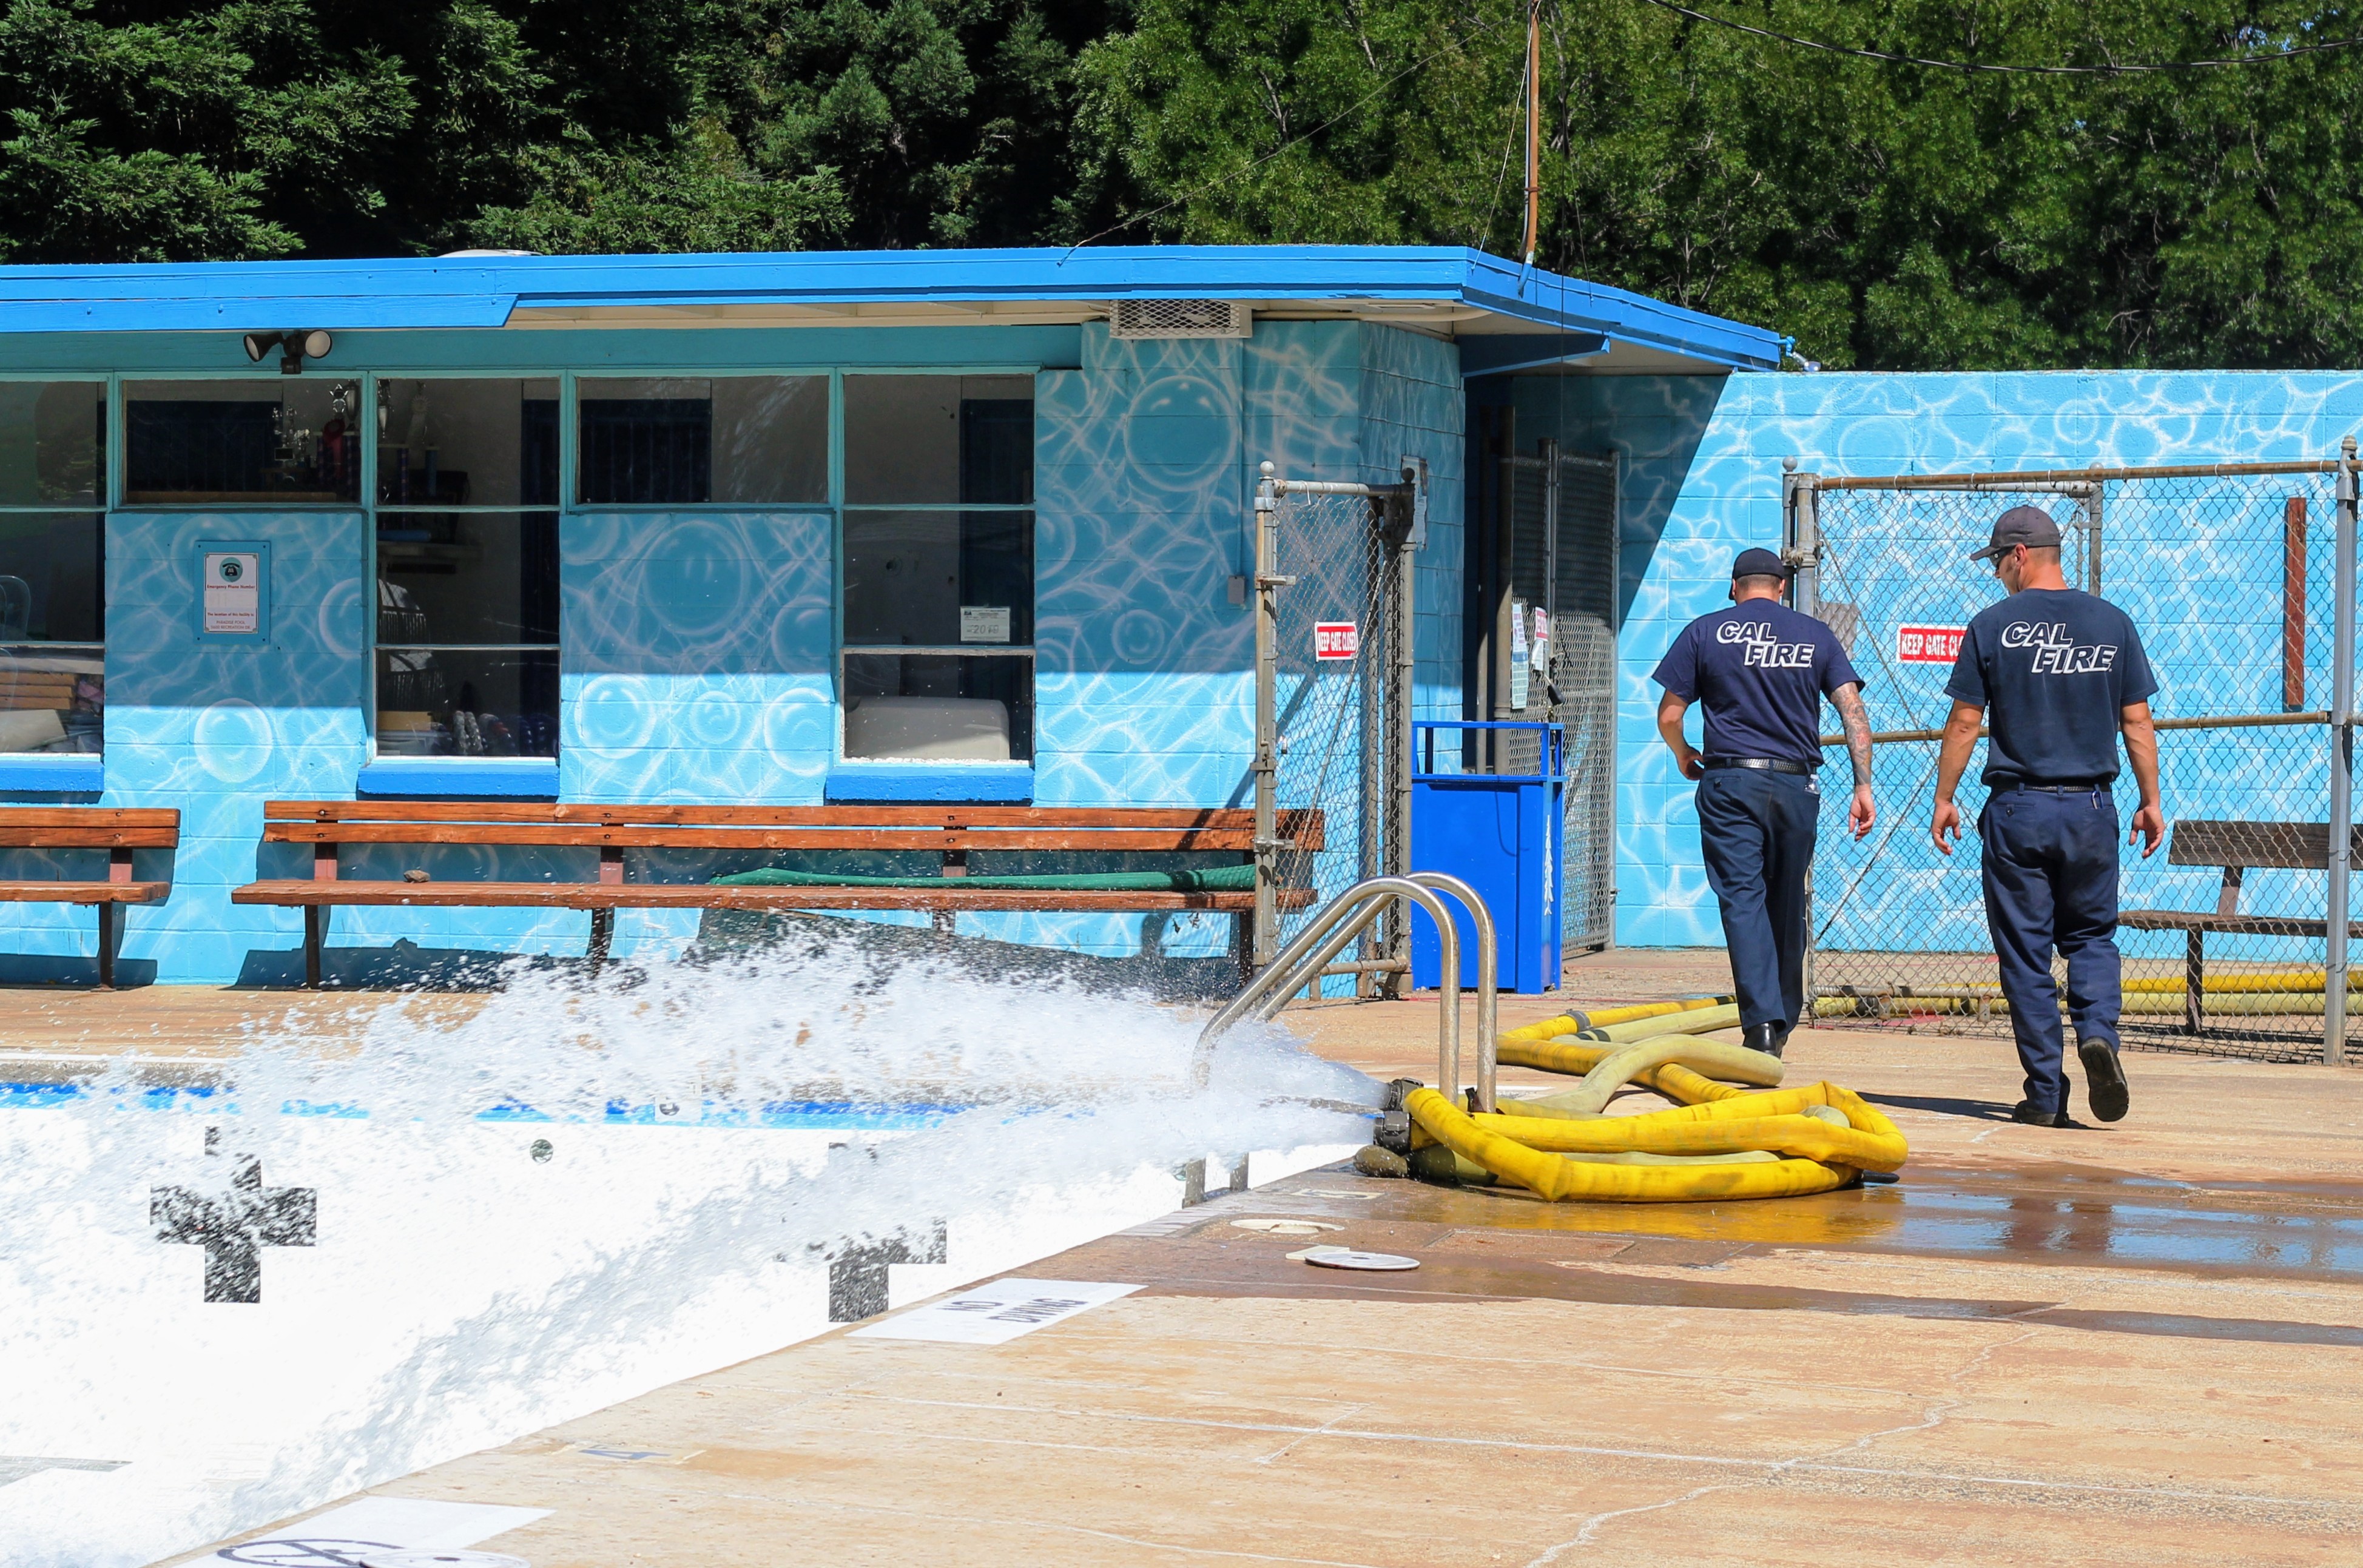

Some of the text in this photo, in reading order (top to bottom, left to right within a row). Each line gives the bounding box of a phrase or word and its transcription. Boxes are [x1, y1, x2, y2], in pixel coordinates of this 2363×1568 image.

[1318, 631, 1357, 651] KEEP GATE CLOSED
[1716, 621, 1777, 644] CAL
[1901, 633, 1923, 655] KEEP
[1926, 634, 1946, 656] GATE
[2001, 621, 2074, 648] CAL
[1744, 643, 1815, 668] FIRE
[2031, 644, 2118, 674] FIRE
